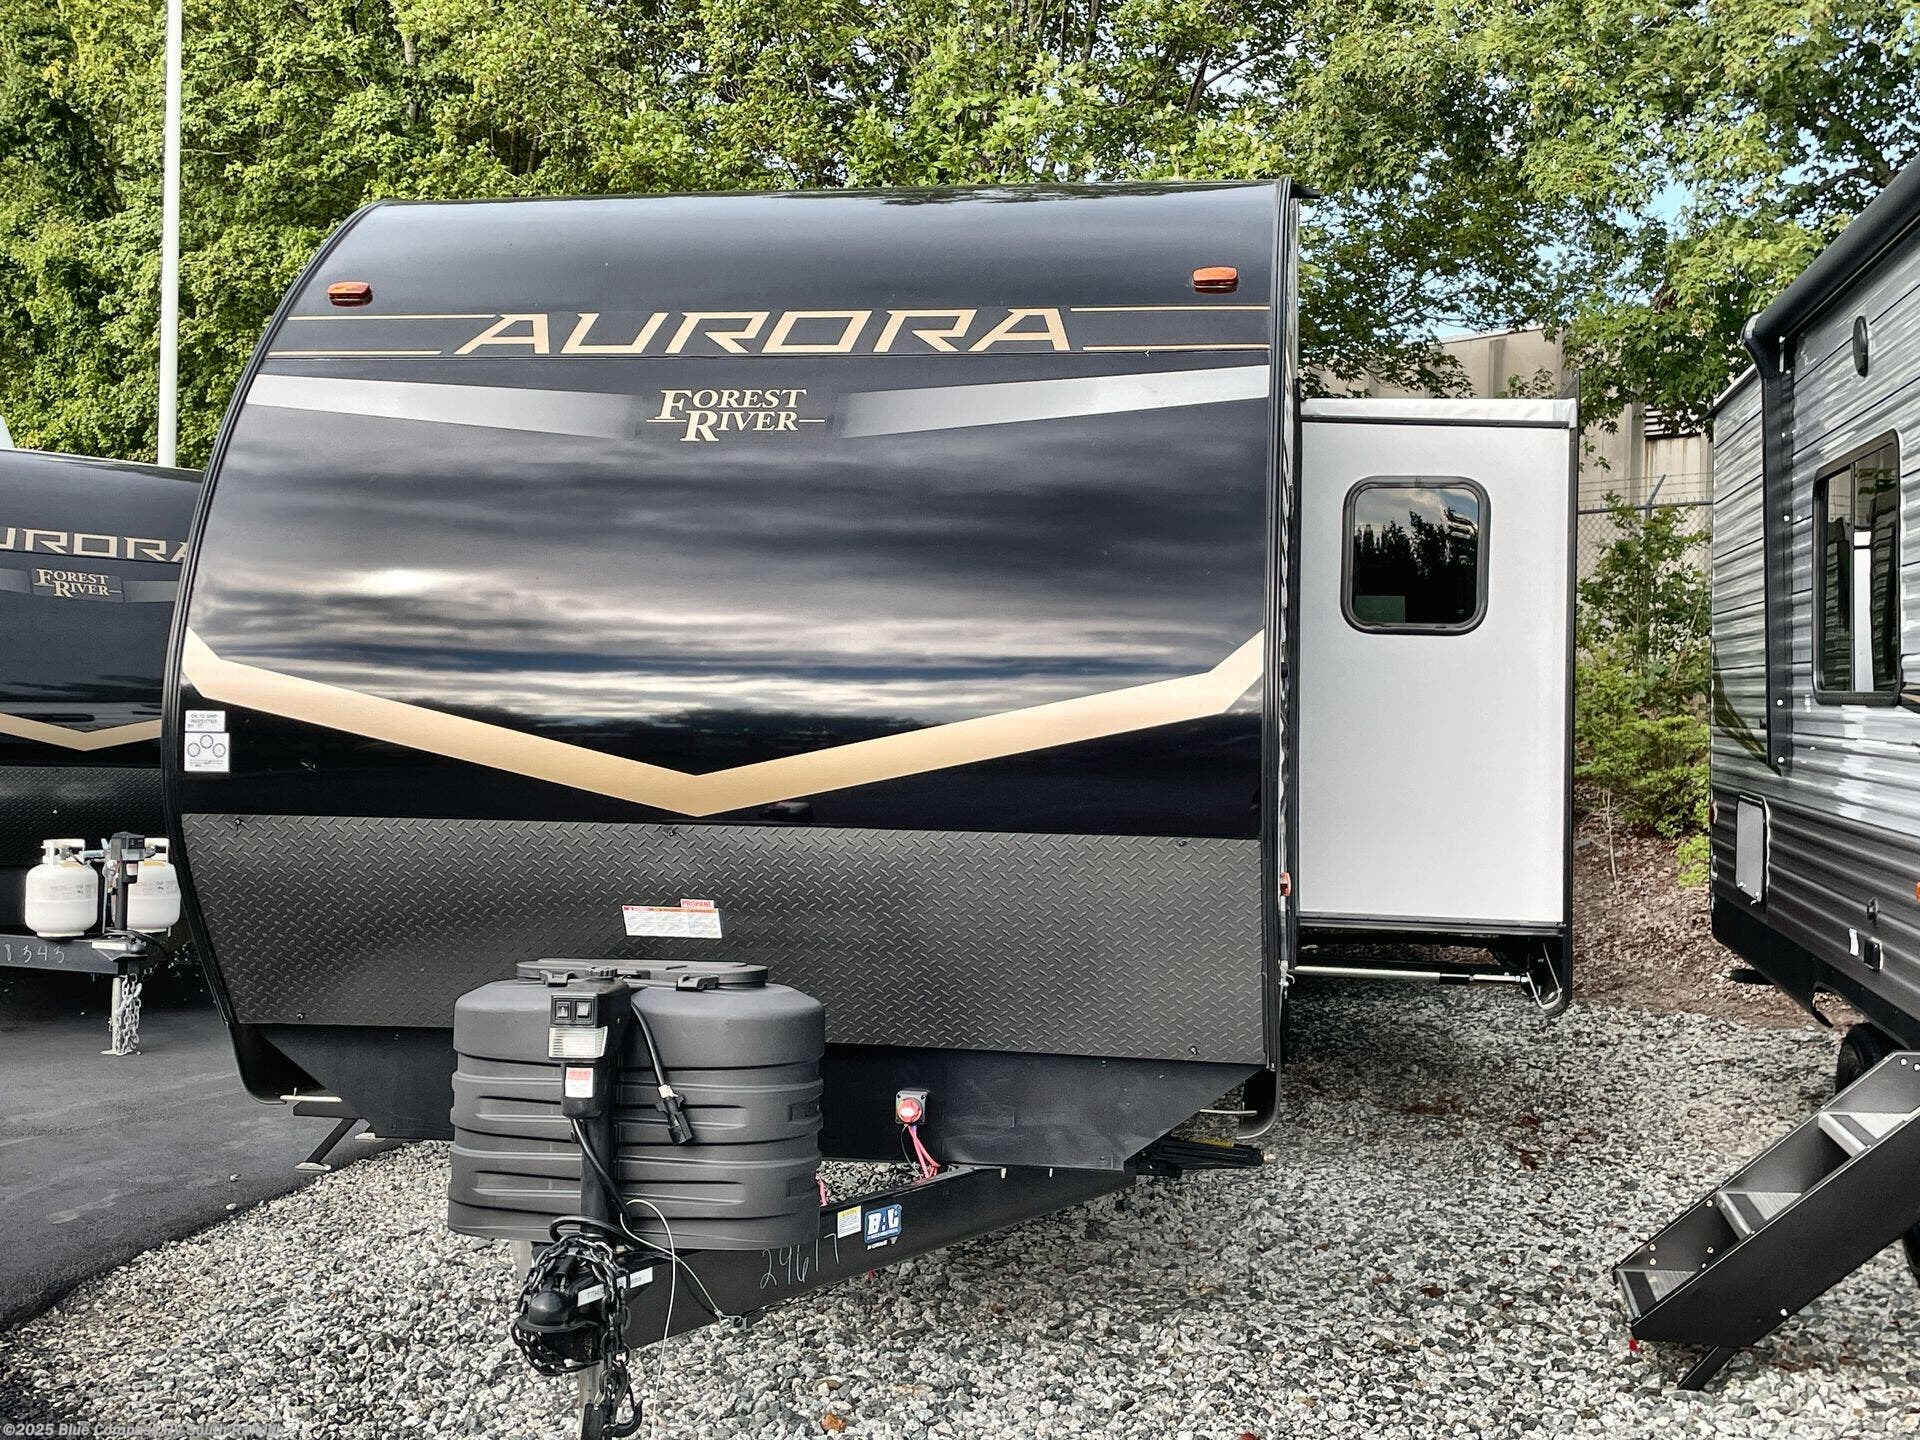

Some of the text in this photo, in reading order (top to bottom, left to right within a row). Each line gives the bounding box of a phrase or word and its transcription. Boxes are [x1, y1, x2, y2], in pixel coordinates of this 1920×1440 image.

[454, 308, 1071, 355] AURORA
[654, 388, 807, 420] FOREST
[679, 410, 799, 442] RIVER
[36, 568, 109, 586] FOREST
[53, 580, 110, 598] RIVER
